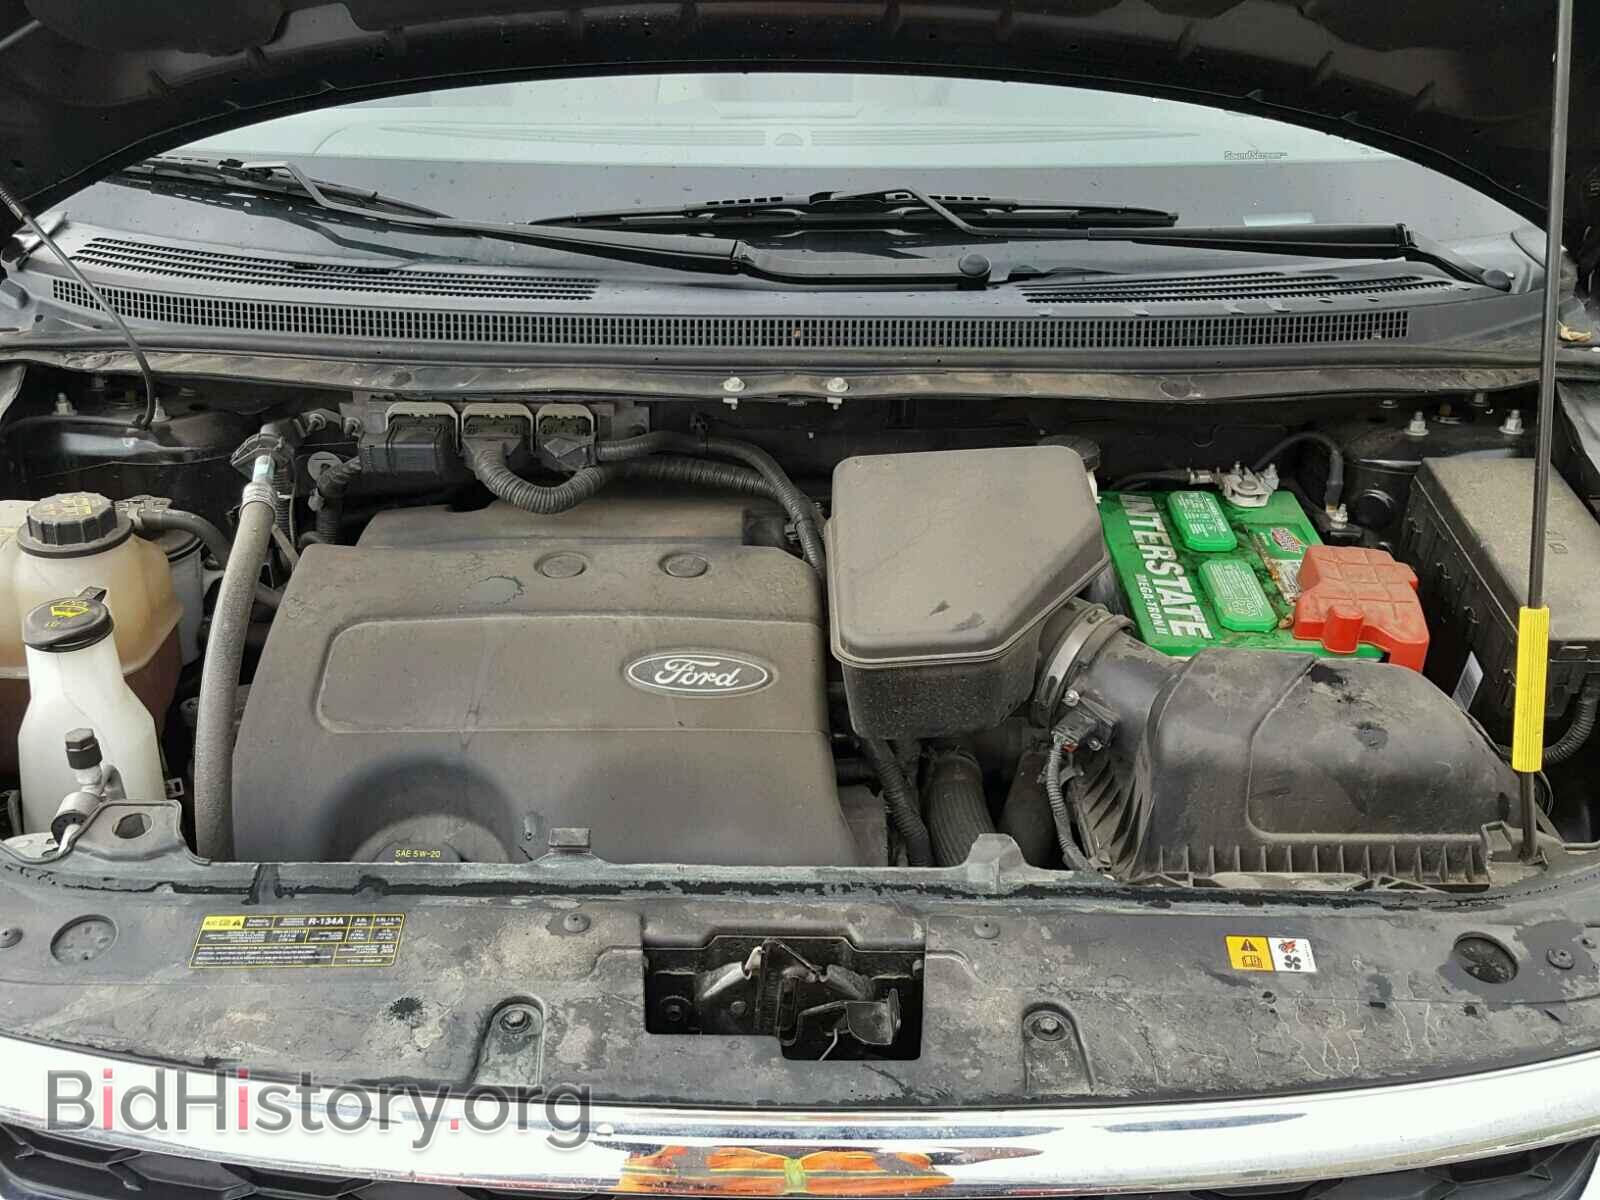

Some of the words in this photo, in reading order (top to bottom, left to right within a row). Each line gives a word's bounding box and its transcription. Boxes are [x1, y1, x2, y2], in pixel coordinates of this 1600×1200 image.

[1120, 494, 1213, 639] INTERSTATE
[654, 658, 742, 687] Ford
[395, 849, 410, 858] SAE
[308, 918, 344, 926] R-134A
